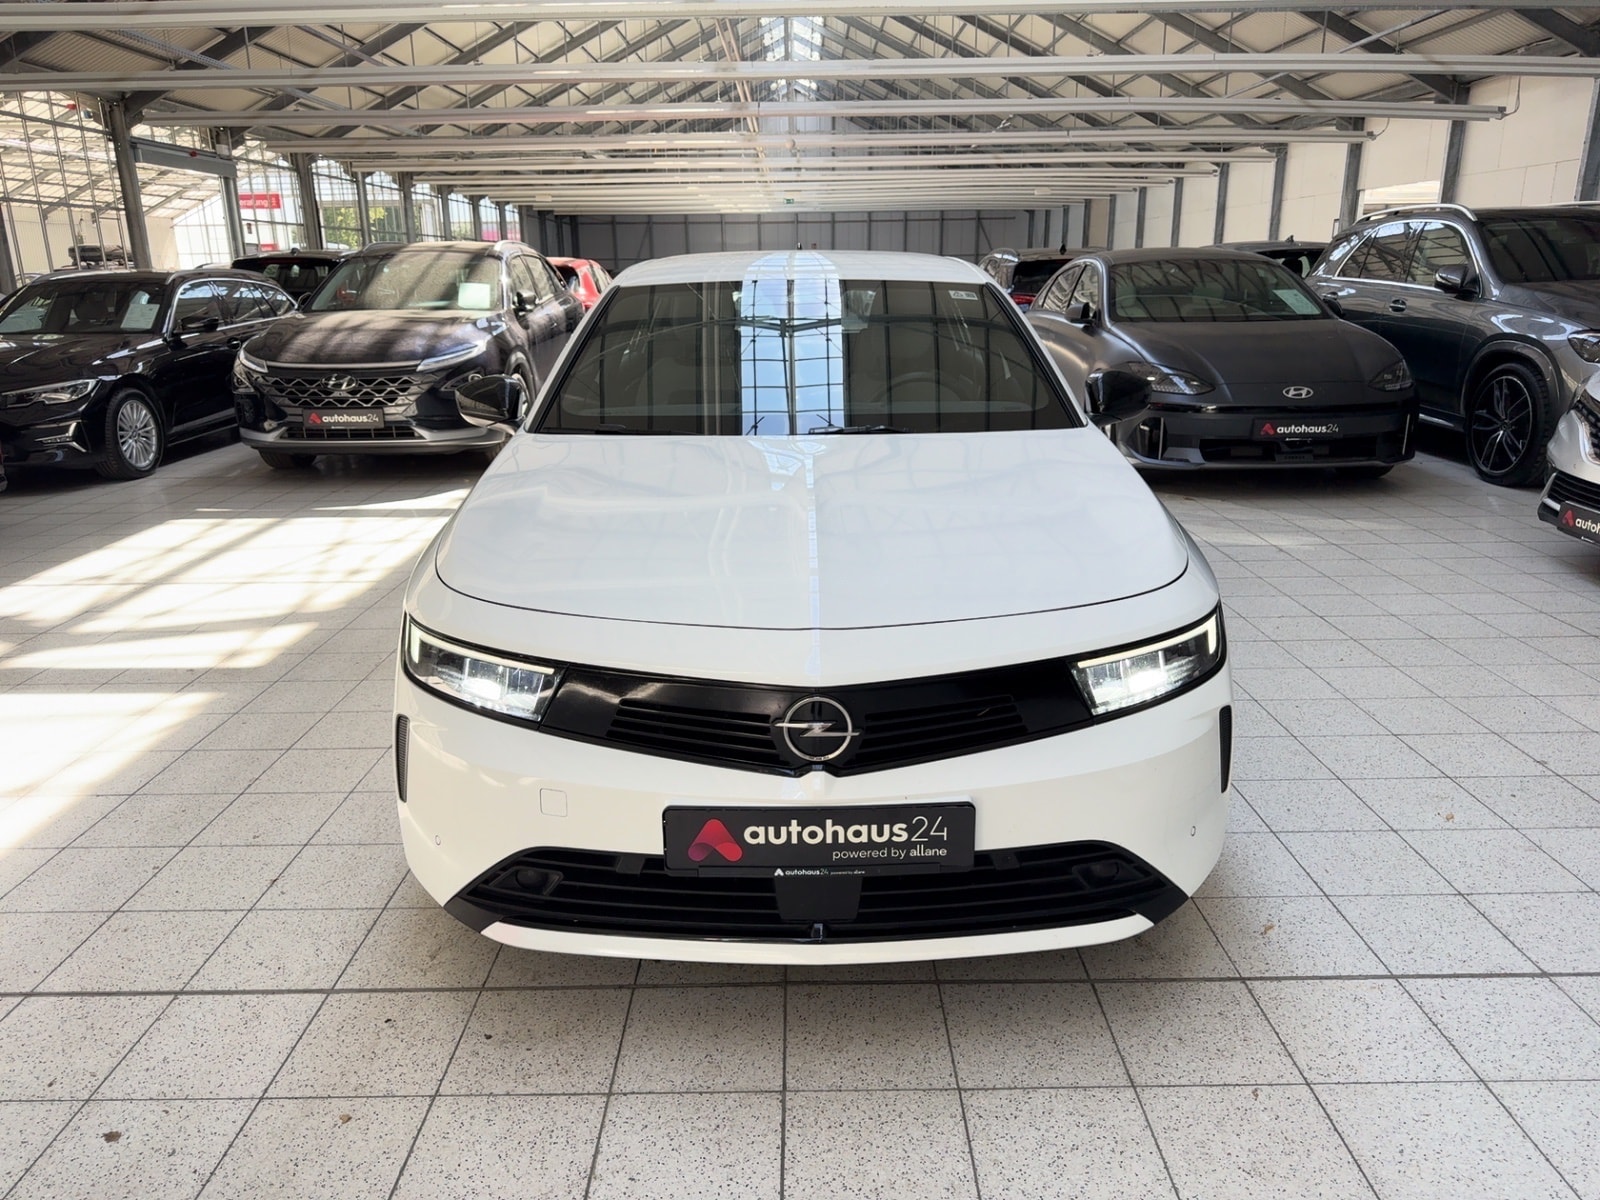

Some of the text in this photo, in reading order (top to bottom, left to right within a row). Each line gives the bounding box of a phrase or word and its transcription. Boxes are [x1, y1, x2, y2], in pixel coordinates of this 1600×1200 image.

[322, 413, 379, 423] autohaus24
[1276, 423, 1339, 434] autohaus24
[743, 815, 948, 845] autohaus24
[832, 844, 947, 861] powered by allane
